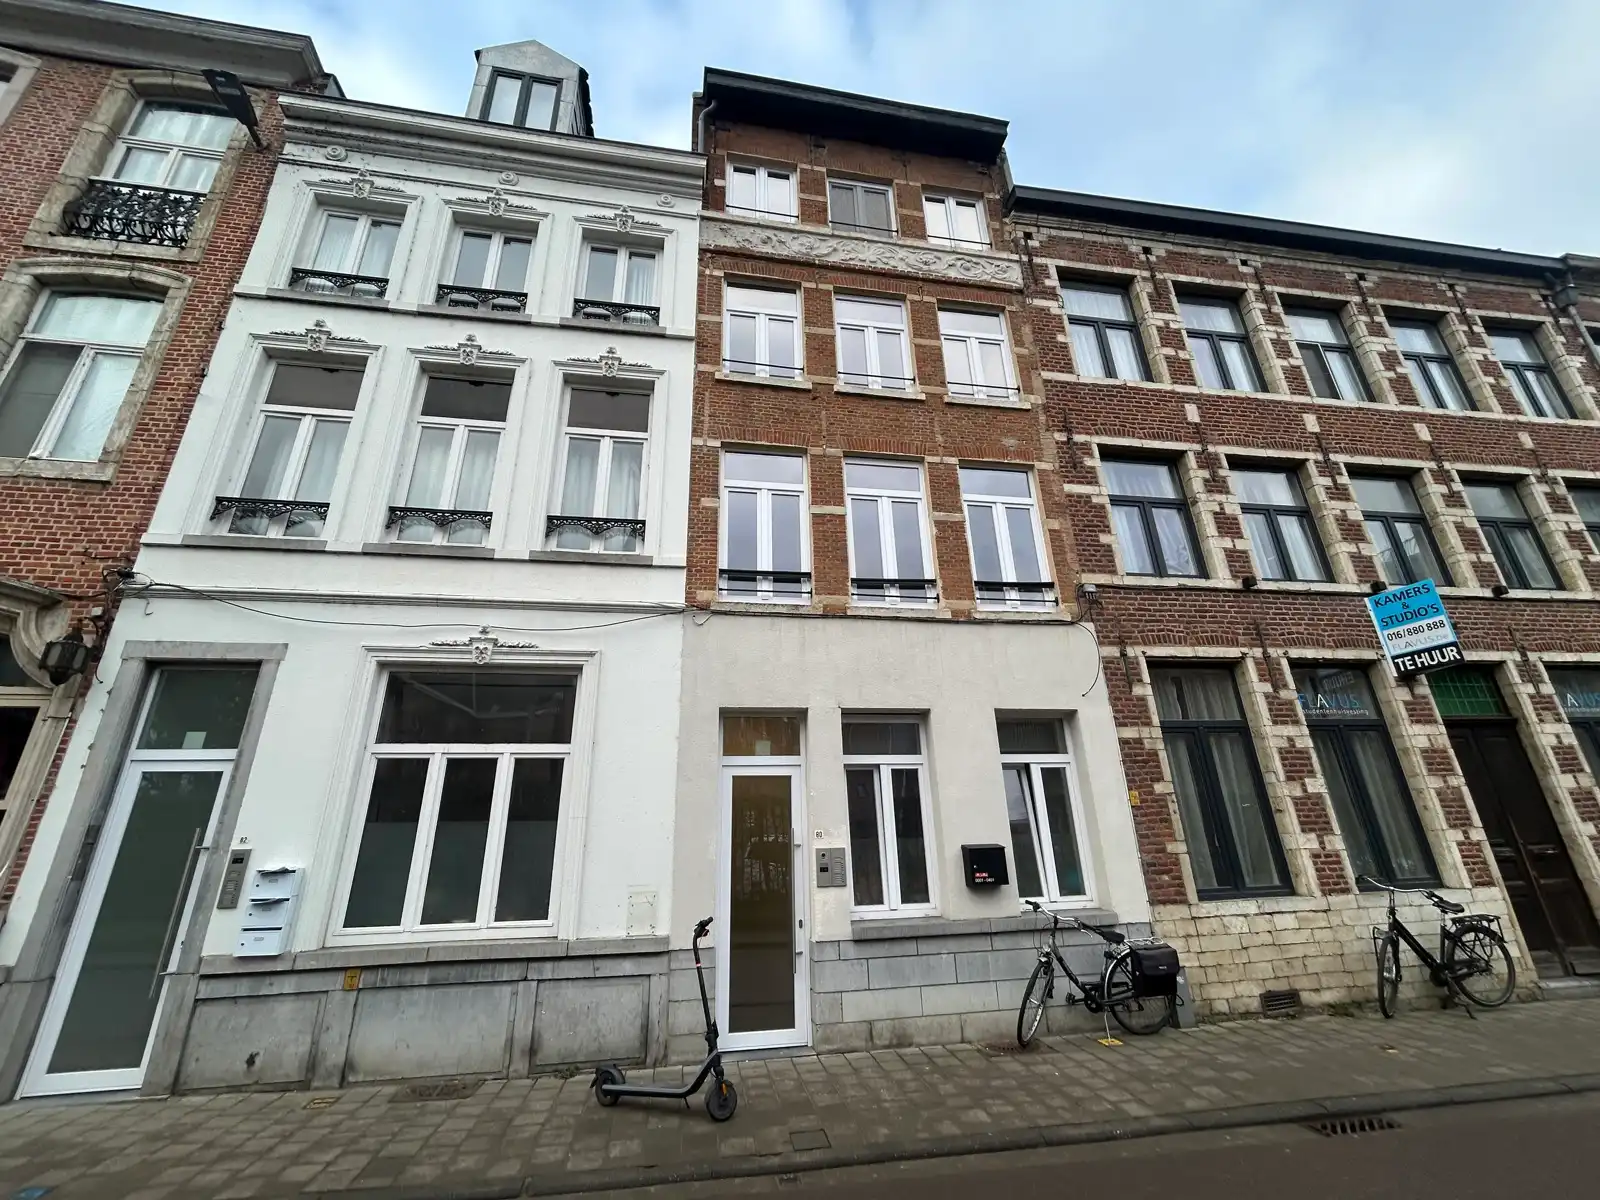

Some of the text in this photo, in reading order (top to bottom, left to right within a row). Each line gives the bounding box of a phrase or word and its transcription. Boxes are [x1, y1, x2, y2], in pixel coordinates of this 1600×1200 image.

[1375, 583, 1430, 608] KAMERS
[1381, 603, 1439, 627] STUDIO'S
[1387, 619, 1446, 641] 016/880 888
[1395, 646, 1461, 671] TE HUUR
